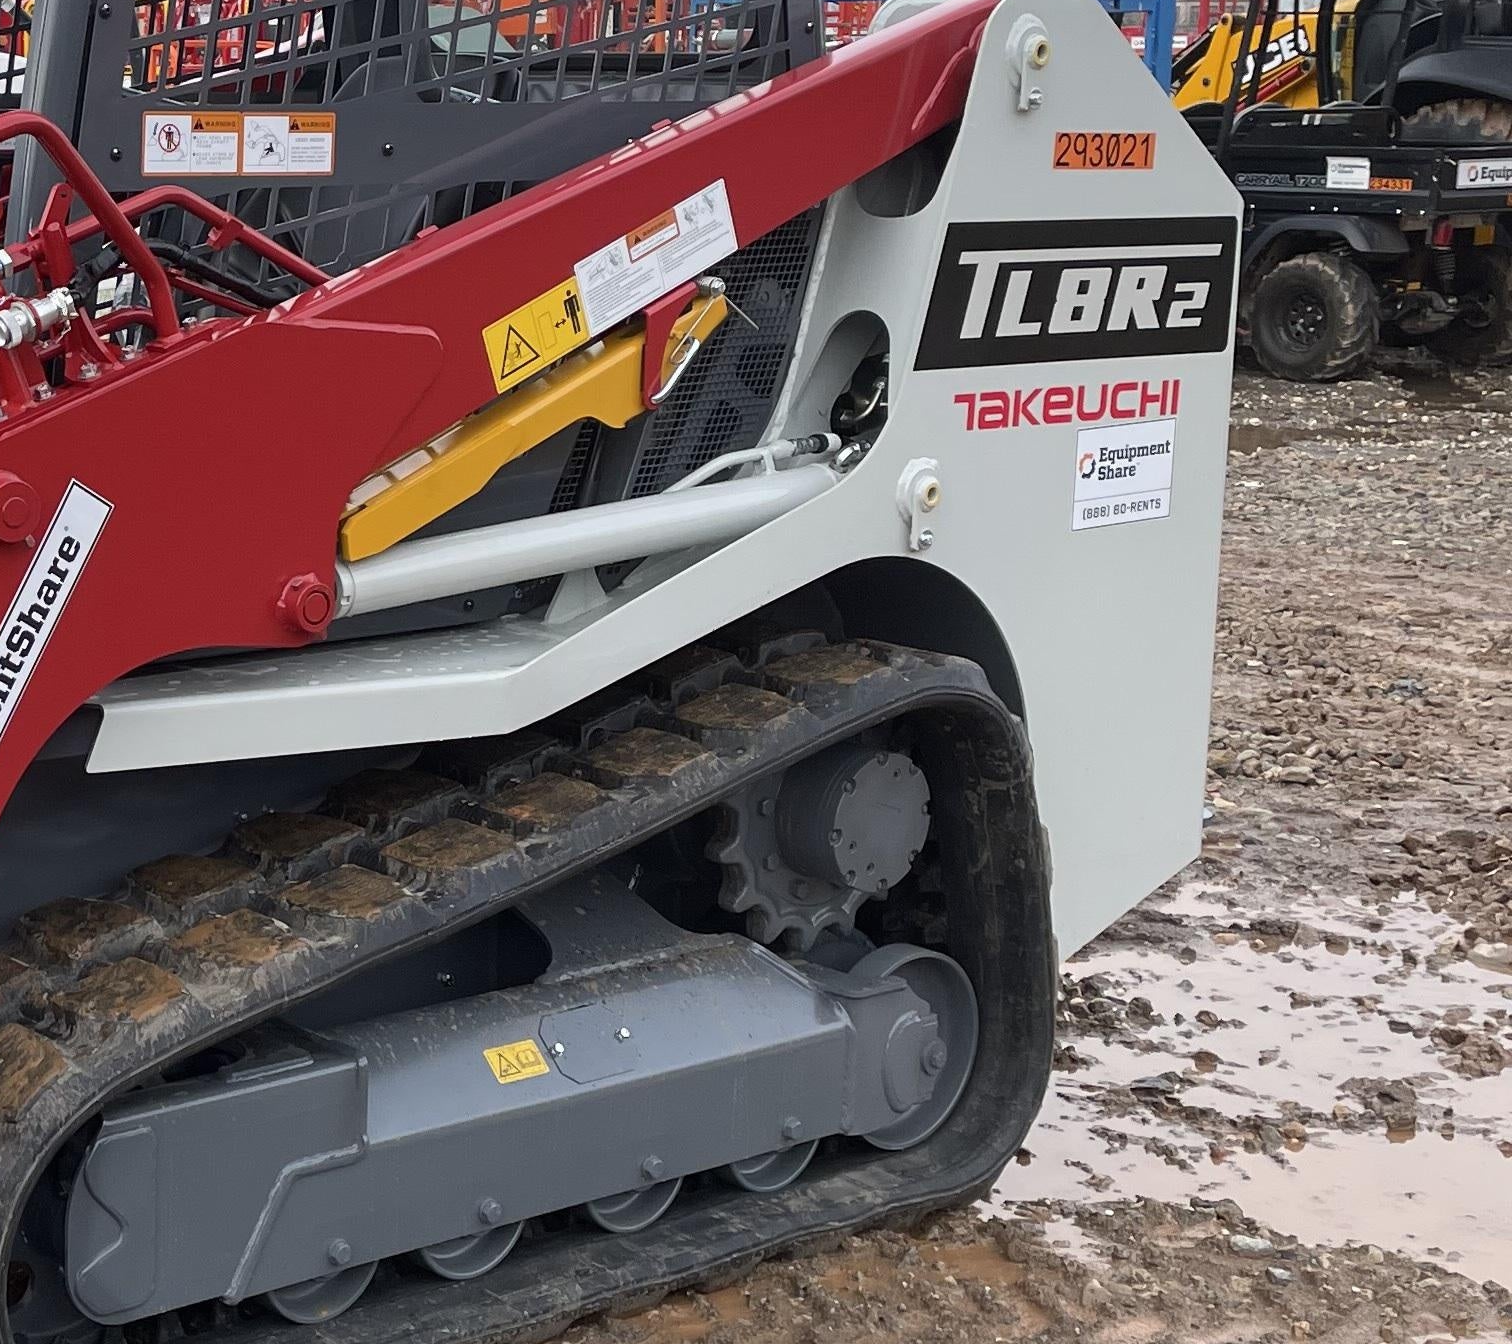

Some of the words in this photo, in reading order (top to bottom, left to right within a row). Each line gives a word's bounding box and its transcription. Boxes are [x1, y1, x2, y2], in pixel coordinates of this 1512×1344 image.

[1055, 133, 1152, 167] 293021
[958, 243, 1223, 340] TL8R2
[953, 379, 1181, 431] TAKEUCHI
[1099, 440, 1171, 465] Equipment
[1097, 464, 1137, 481] Share
[1082, 505, 1110, 521] (888)
[1113, 498, 1162, 516] 80-RENTS
